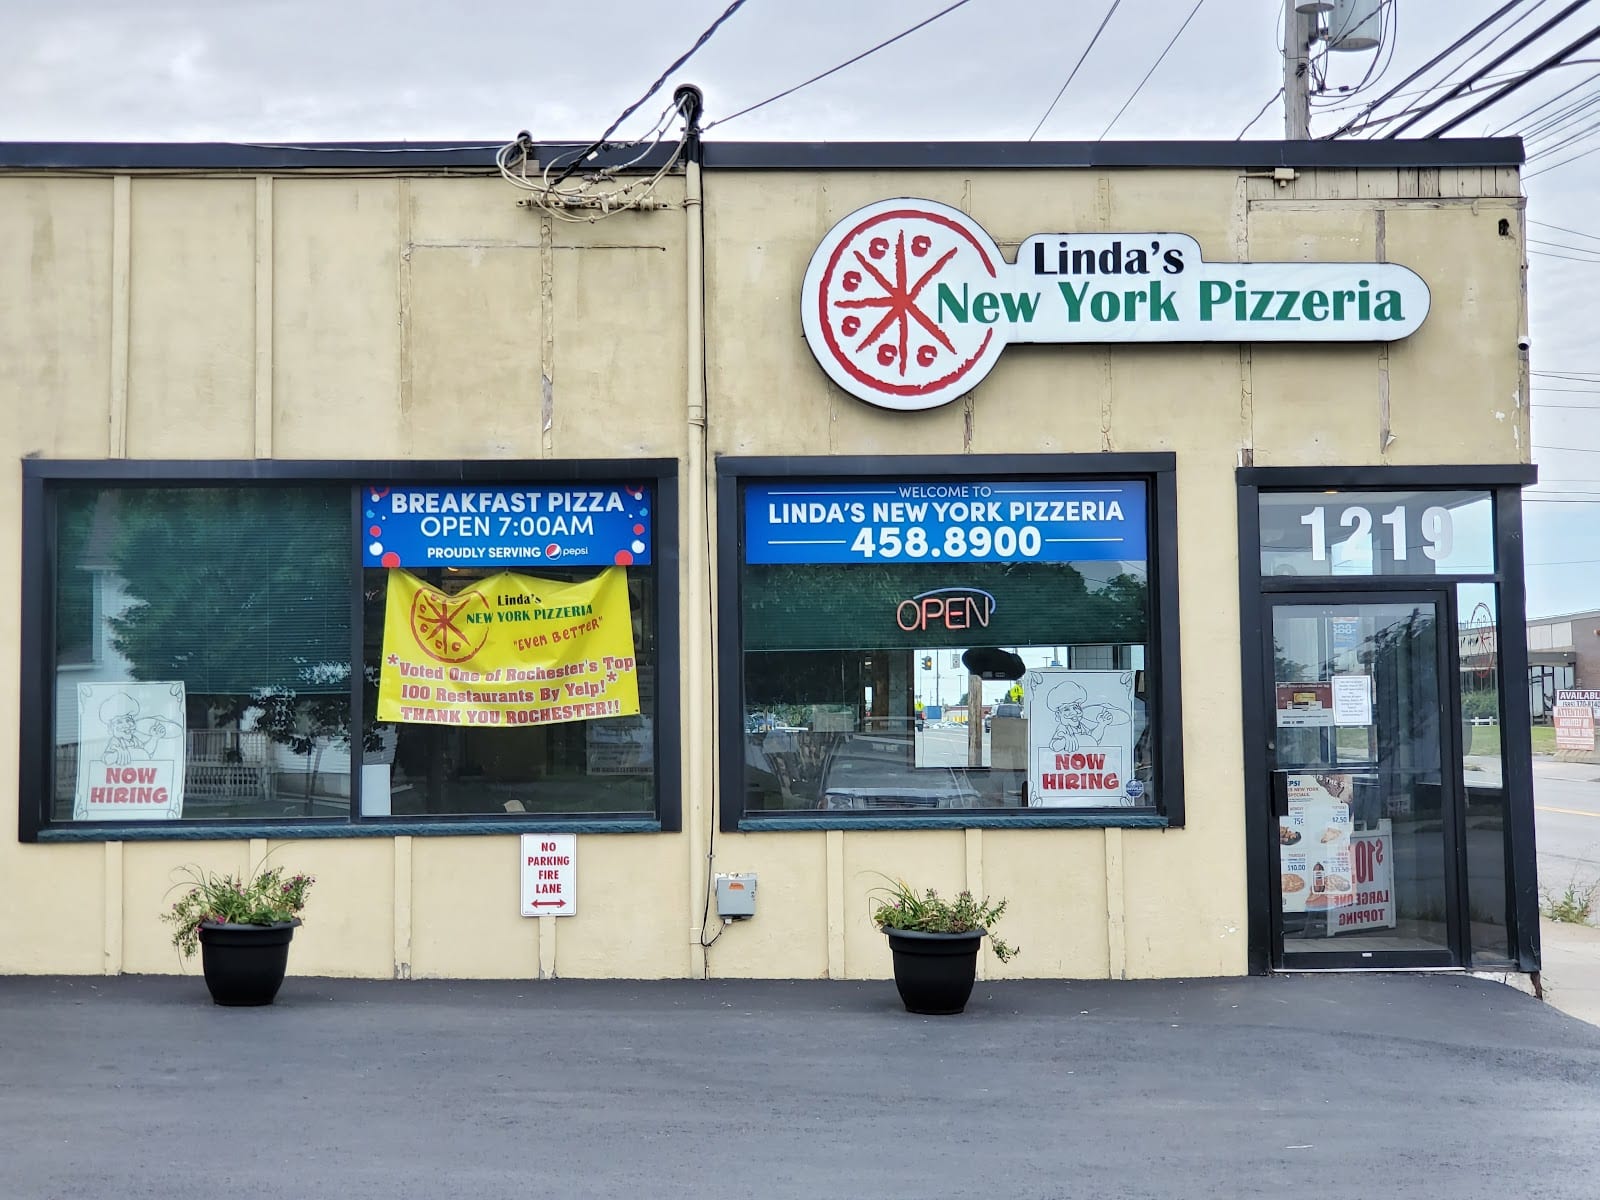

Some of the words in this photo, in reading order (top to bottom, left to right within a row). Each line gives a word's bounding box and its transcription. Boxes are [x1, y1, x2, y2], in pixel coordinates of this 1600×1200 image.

[1034, 241, 1185, 275] Linda's
[938, 282, 1041, 323] New
[1058, 281, 1180, 323] York
[1199, 280, 1406, 321] Pizzeria
[899, 486, 969, 498] WELCOME
[972, 486, 991, 498] TO
[392, 492, 541, 513] BREAKFAST
[548, 491, 625, 512] PIZZA
[769, 503, 866, 524] LINDA'S
[873, 502, 928, 523] NEW
[932, 502, 1004, 522] YORK
[1010, 501, 1124, 522] PIZZERIA
[421, 516, 490, 537] OPEN
[498, 515, 594, 537] 7:00AM
[1300, 505, 1453, 561] 1219
[850, 526, 1042, 558] 458.8900
[427, 547, 486, 558] PROUDLY
[488, 547, 542, 558] SERVING
[563, 546, 588, 557] pepsi
[497, 594, 542, 606] Linda's
[466, 612, 494, 624] NEW
[497, 610, 531, 622] YORK
[534, 604, 593, 620] PIZZERIA
[897, 597, 989, 631] OPEN
[449, 667, 480, 681] One
[485, 669, 501, 681] of
[506, 659, 598, 681] Rochester's
[603, 656, 633, 671] Top
[402, 685, 430, 699] 100
[436, 687, 534, 703] Restaurants
[540, 687, 560, 702] By
[401, 707, 460, 723] THANK
[467, 711, 500, 723] YOU
[506, 700, 620, 724] ROCHESTER!!
[1557, 707, 1589, 717] ATTENTION
[1055, 753, 1106, 770] NOW
[105, 767, 157, 785] NOW
[1042, 772, 1120, 790] HIRING
[90, 786, 168, 804] HIRING
[541, 842, 556, 852] NO
[528, 856, 570, 866] PARKING
[538, 870, 559, 880] FIRE
[536, 884, 562, 894] LANE
